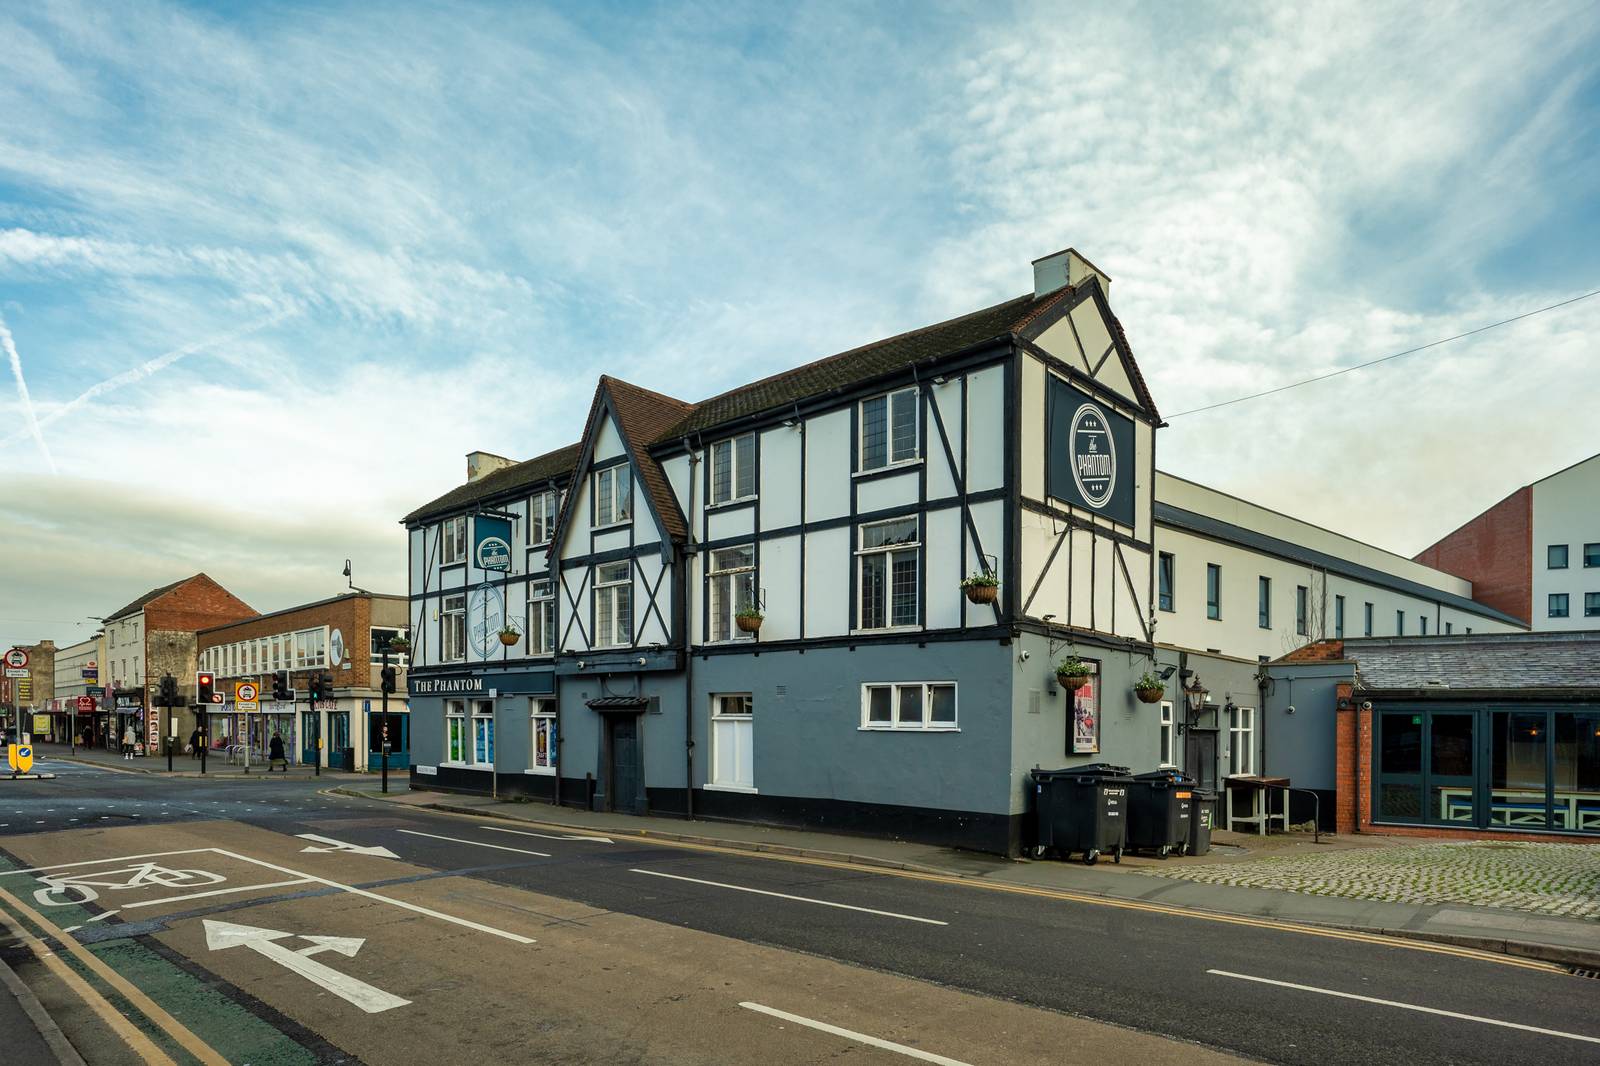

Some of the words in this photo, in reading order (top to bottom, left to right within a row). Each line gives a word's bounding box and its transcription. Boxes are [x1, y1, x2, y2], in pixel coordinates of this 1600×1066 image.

[1089, 437, 1097, 451] the
[1077, 454, 1111, 476] PHANTOM
[483, 554, 508, 565] PHANTOM
[414, 680, 432, 692] THE
[434, 679, 482, 692] PHANTOM
